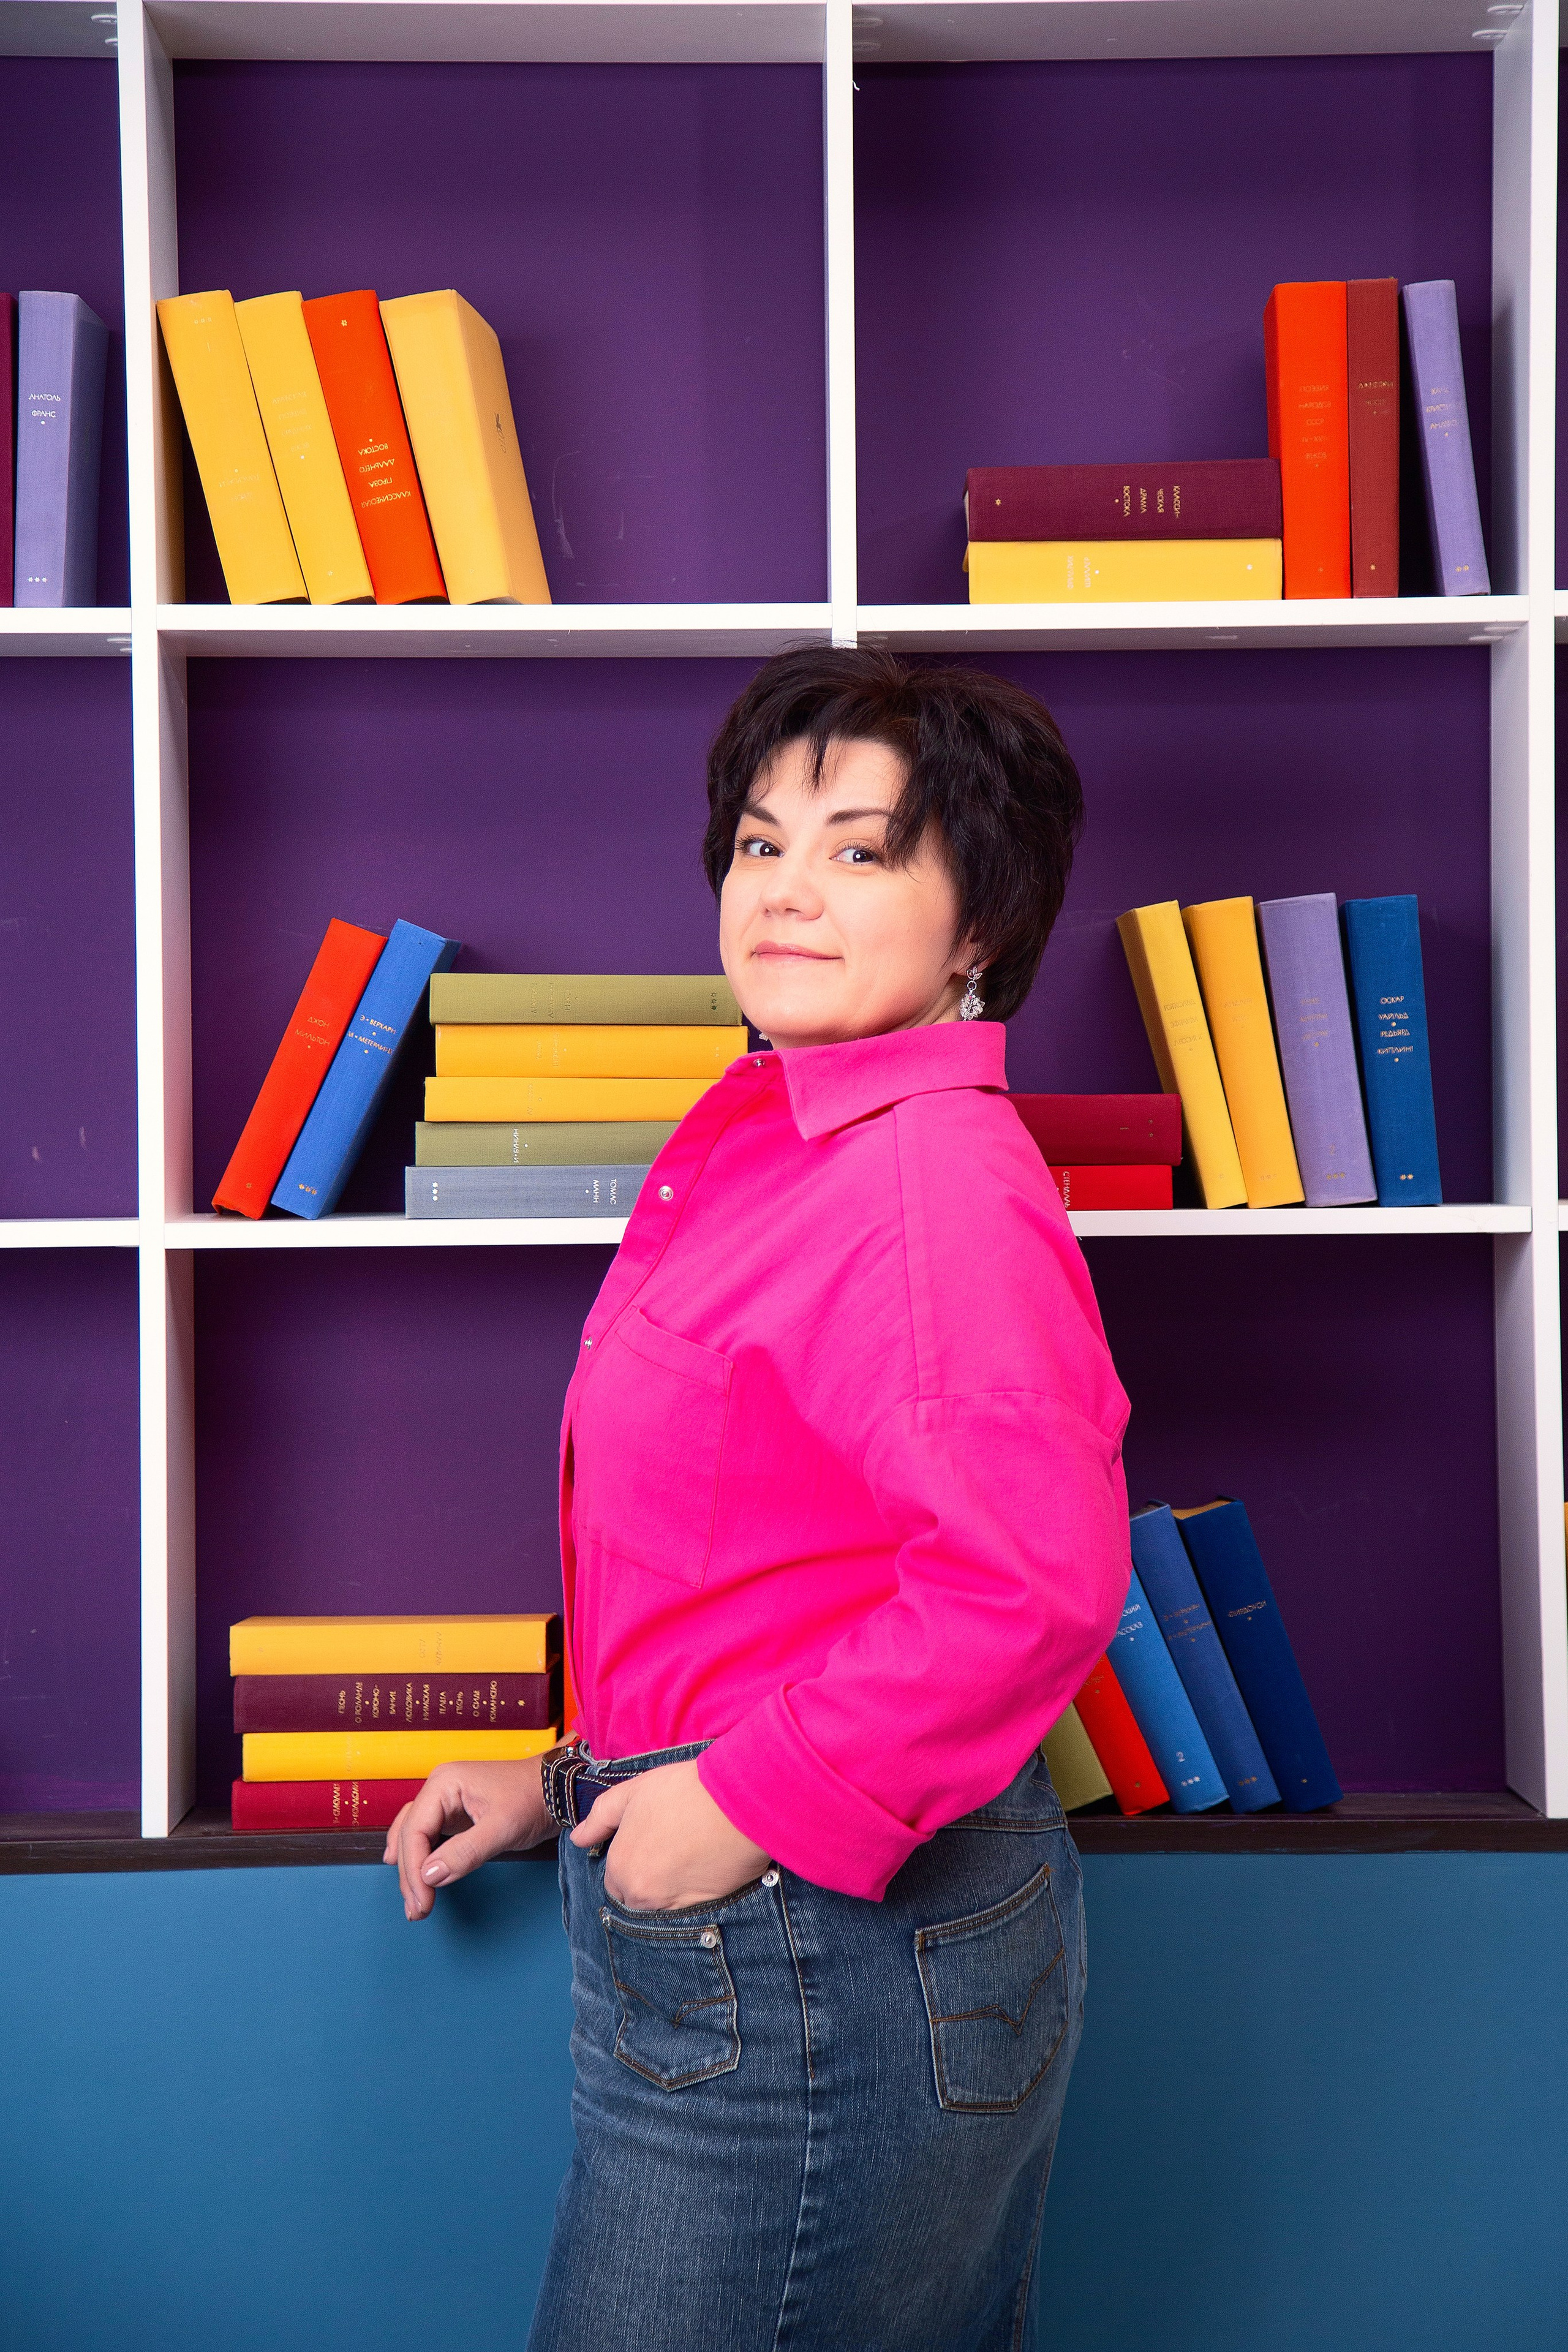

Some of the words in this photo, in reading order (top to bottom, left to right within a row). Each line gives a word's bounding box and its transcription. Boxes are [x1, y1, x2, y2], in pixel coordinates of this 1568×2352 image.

[28, 393, 61, 402] АНАТОЛЬ
[31, 410, 57, 418] ФРАНС
[1305, 418, 1325, 426] СССР
[357, 443, 388, 456] ВОСТОКА
[359, 459, 395, 473] ДАЛЬНЕГО
[368, 477, 393, 488] ПРОЗА
[360, 491, 411, 508] КЛАССИЧЕСКАЯ
[1380, 996, 1404, 1005] ОСКАР
[1378, 1012, 1409, 1020] УАЙЛЬД
[307, 1016, 330, 1028] ДЖОН
[295, 1029, 330, 1046] МИЛЬТОН
[1380, 1029, 1411, 1038] РЕДЬЯРД
[337, 1690, 346, 1714] ПЕСНЬ
[455, 1691, 464, 1715] ПЕСНЬ
[1176, 1752, 1186, 1763] 2
